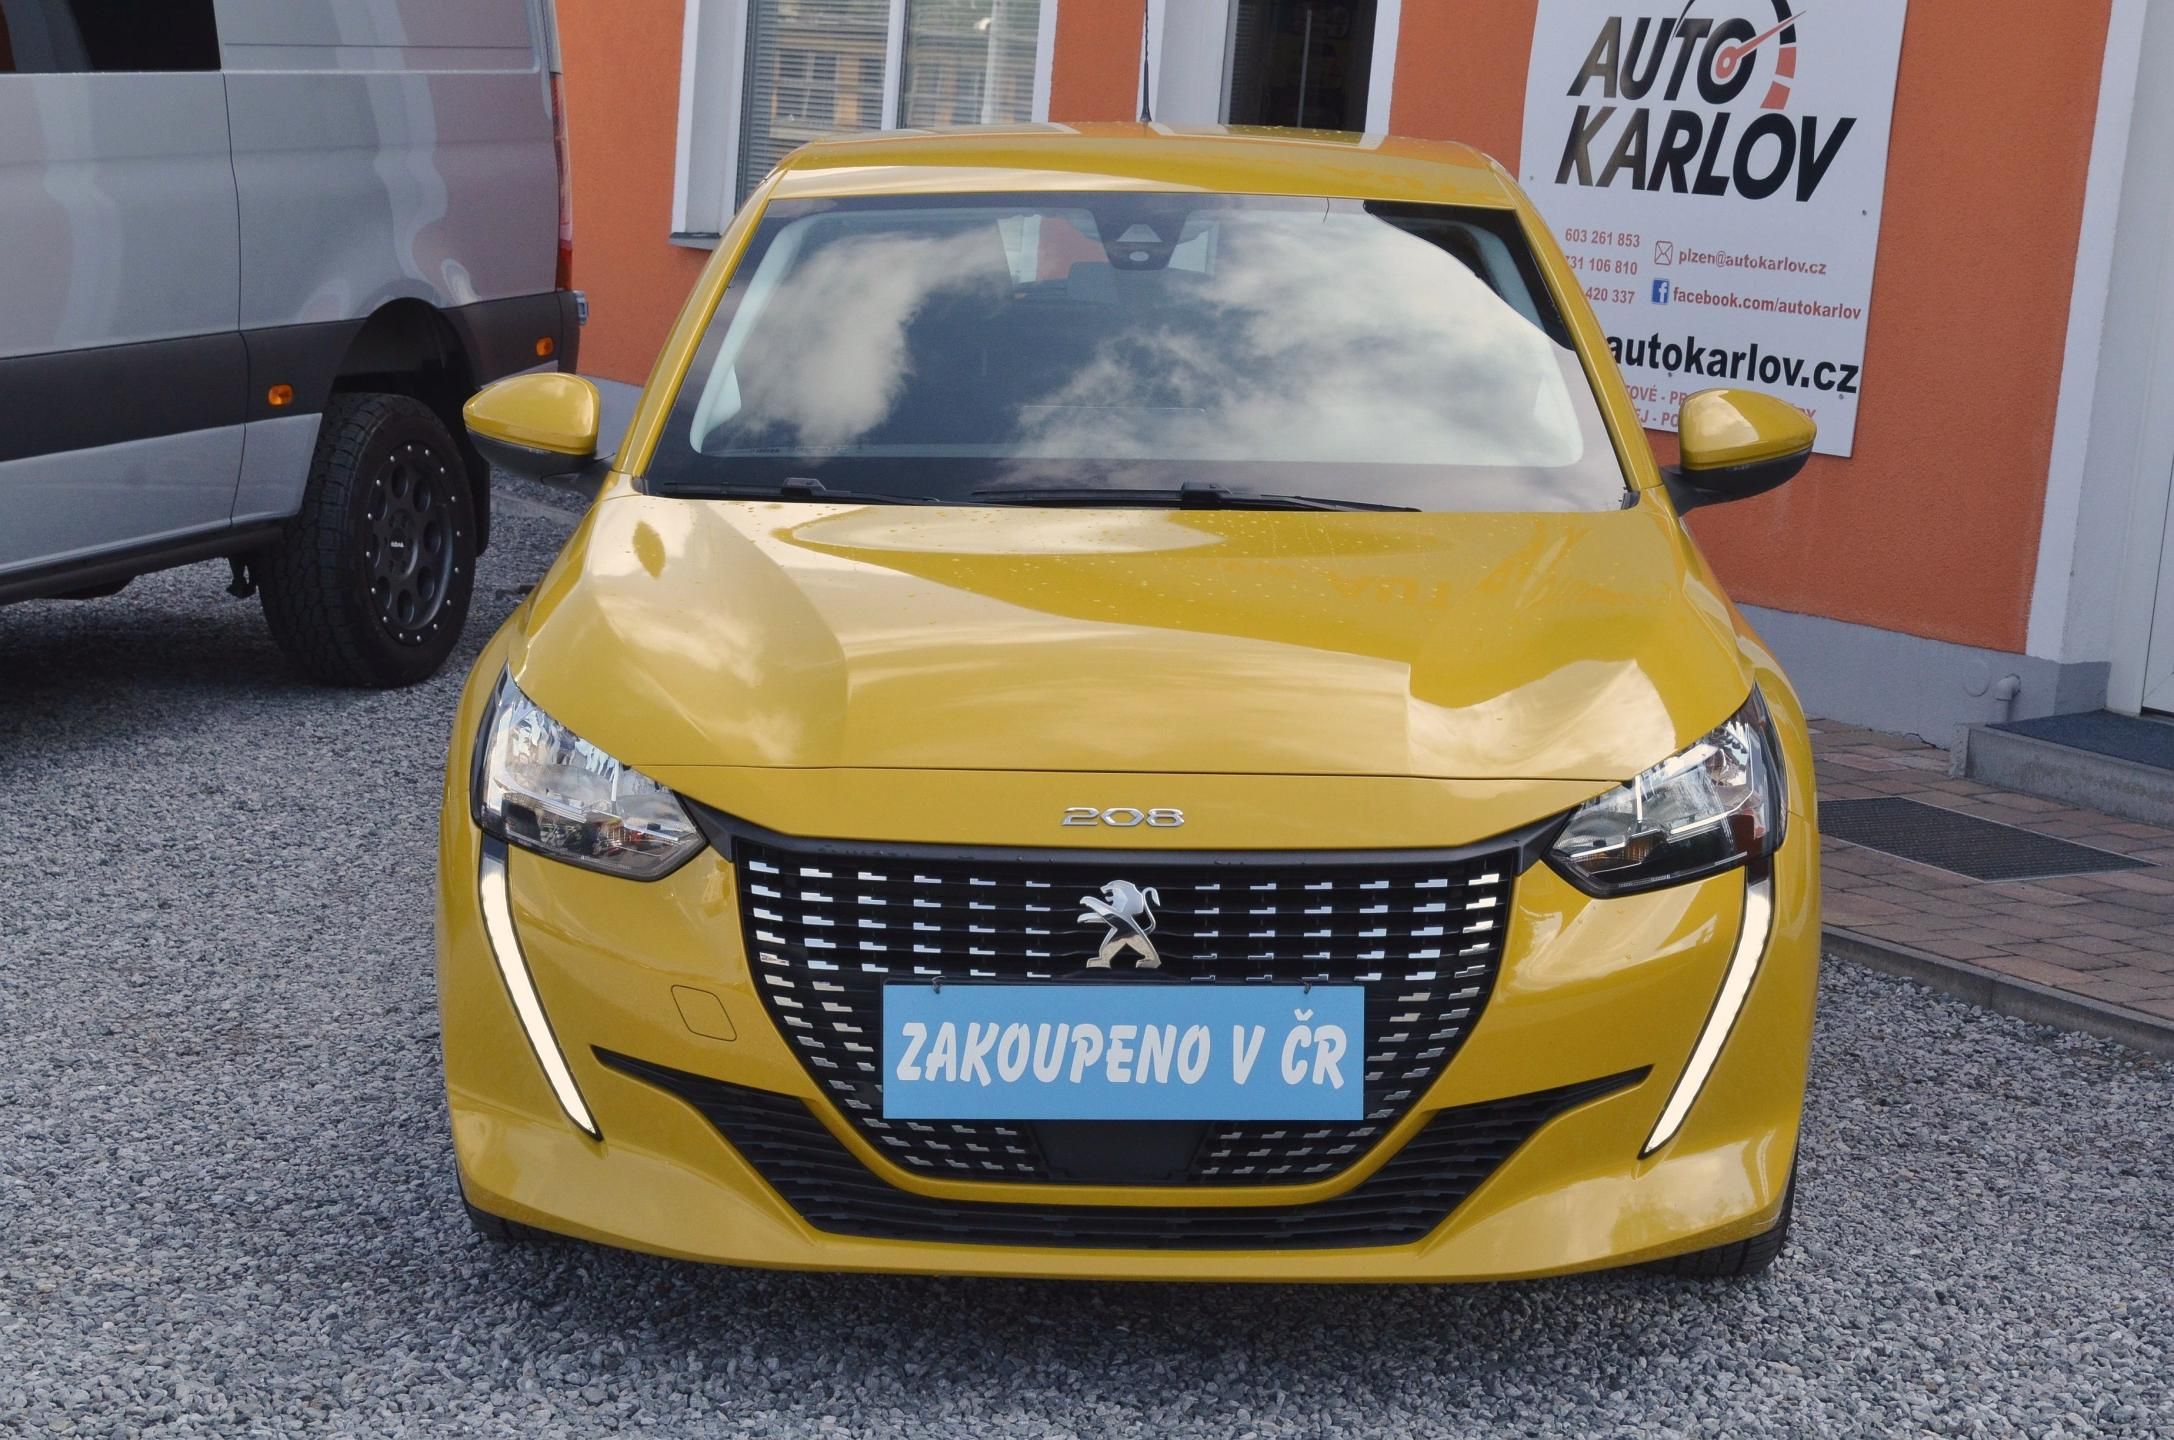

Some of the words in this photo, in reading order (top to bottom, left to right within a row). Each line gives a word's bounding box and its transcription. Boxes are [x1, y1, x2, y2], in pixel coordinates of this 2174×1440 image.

[1566, 16, 1757, 105] AUTO
[1554, 105, 1857, 202] KARLOV
[1565, 228, 1587, 243] 603
[1591, 230, 1613, 246] 261
[1617, 232, 1641, 248] 853
[1589, 257, 1611, 273] 106
[1615, 260, 1638, 276] 810
[1678, 248, 1827, 275] plzen@autokarlov.cz
[1612, 289, 1636, 305] 337
[1673, 287, 1862, 320] facebook.com/autokarlov
[1606, 332, 1859, 394] autokarlov.cz
[1061, 806, 1185, 828] 208
[896, 1021, 1211, 1088] ZAKOUPENO
[1232, 1024, 1266, 1086] V
[1280, 1008, 1348, 1090] ČR
